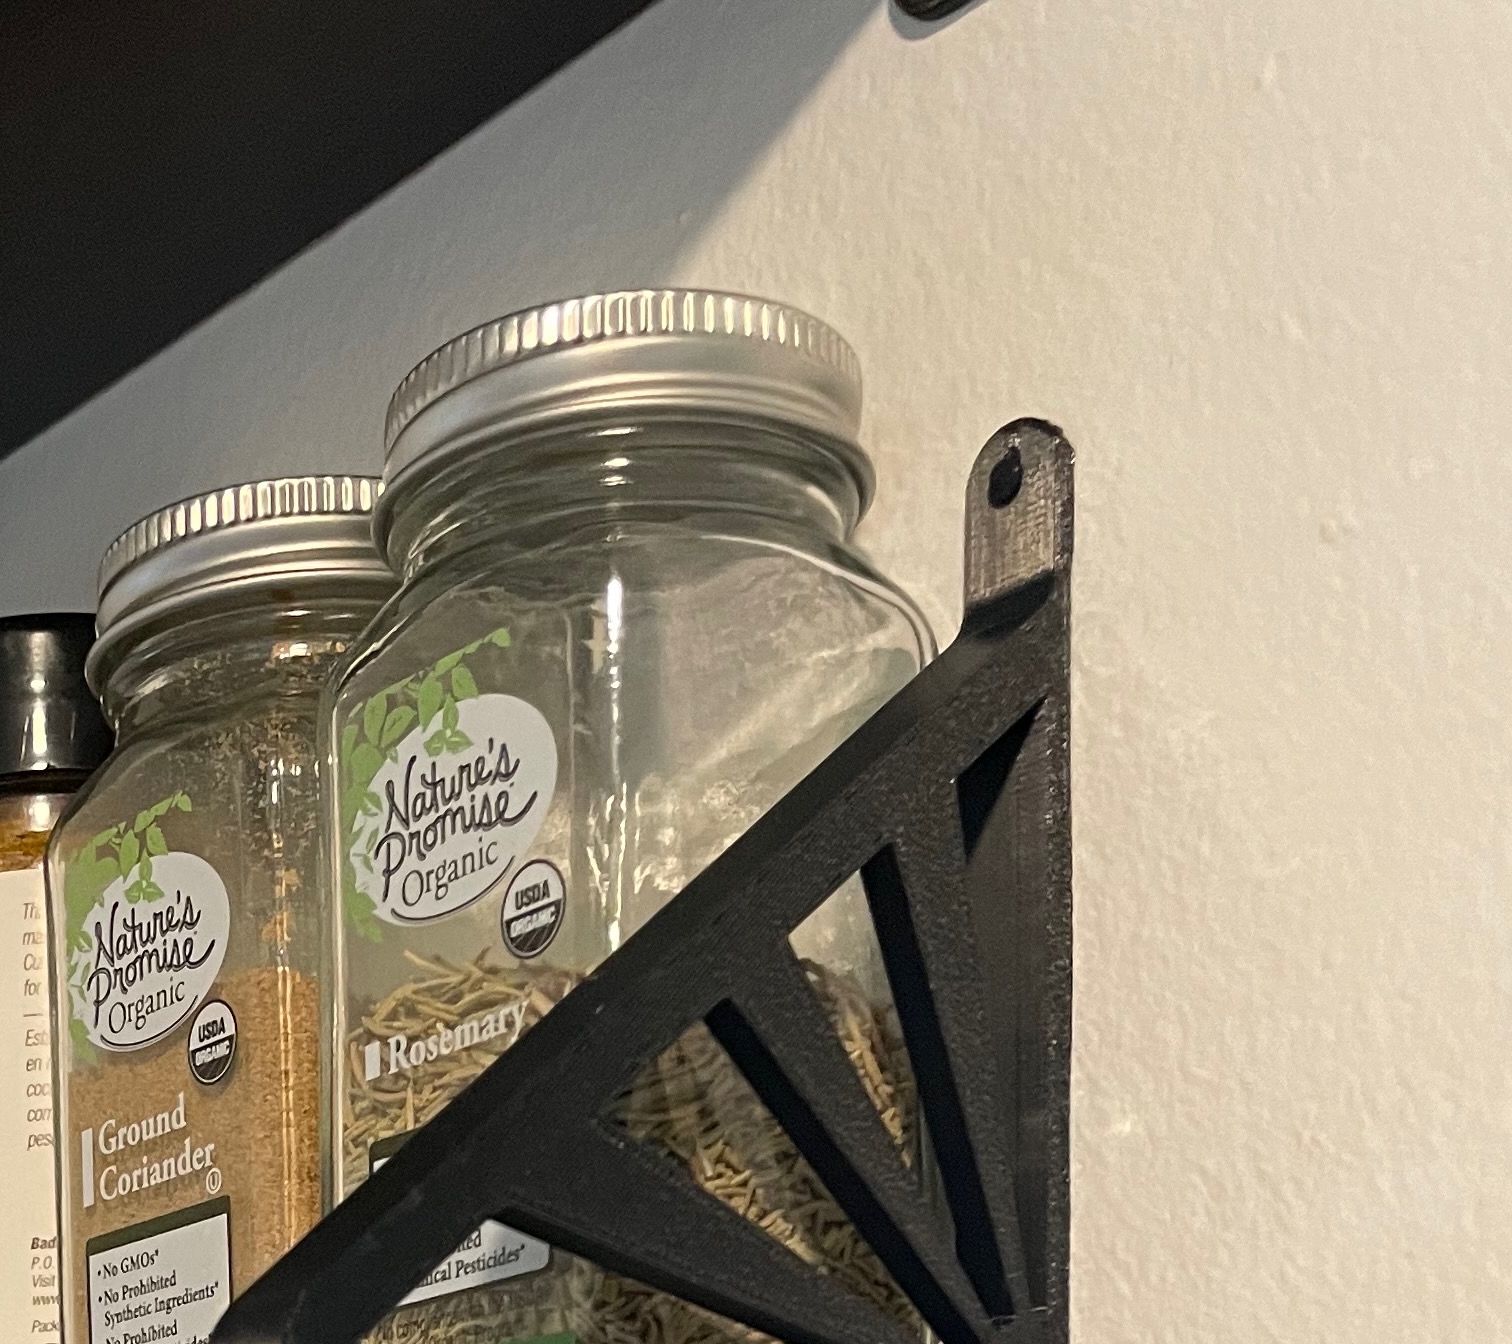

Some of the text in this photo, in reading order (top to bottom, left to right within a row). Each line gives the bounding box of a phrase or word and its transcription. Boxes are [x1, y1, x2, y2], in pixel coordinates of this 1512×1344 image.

[385, 737, 520, 831] Nature's
[374, 790, 538, 902] Promise
[402, 836, 498, 907] Organic
[95, 890, 201, 969] Nature's
[87, 937, 215, 1028] Promise
[109, 976, 185, 1034] Organic
[198, 1017, 226, 1042] USDA
[387, 999, 530, 1075] Rosemary
[98, 1091, 187, 1155] Ground
[99, 1136, 215, 1201] Coriander
[103, 1262, 119, 1280] No
[104, 1269, 177, 1306] No Prohibited
[104, 1302, 152, 1330] Synthetic
